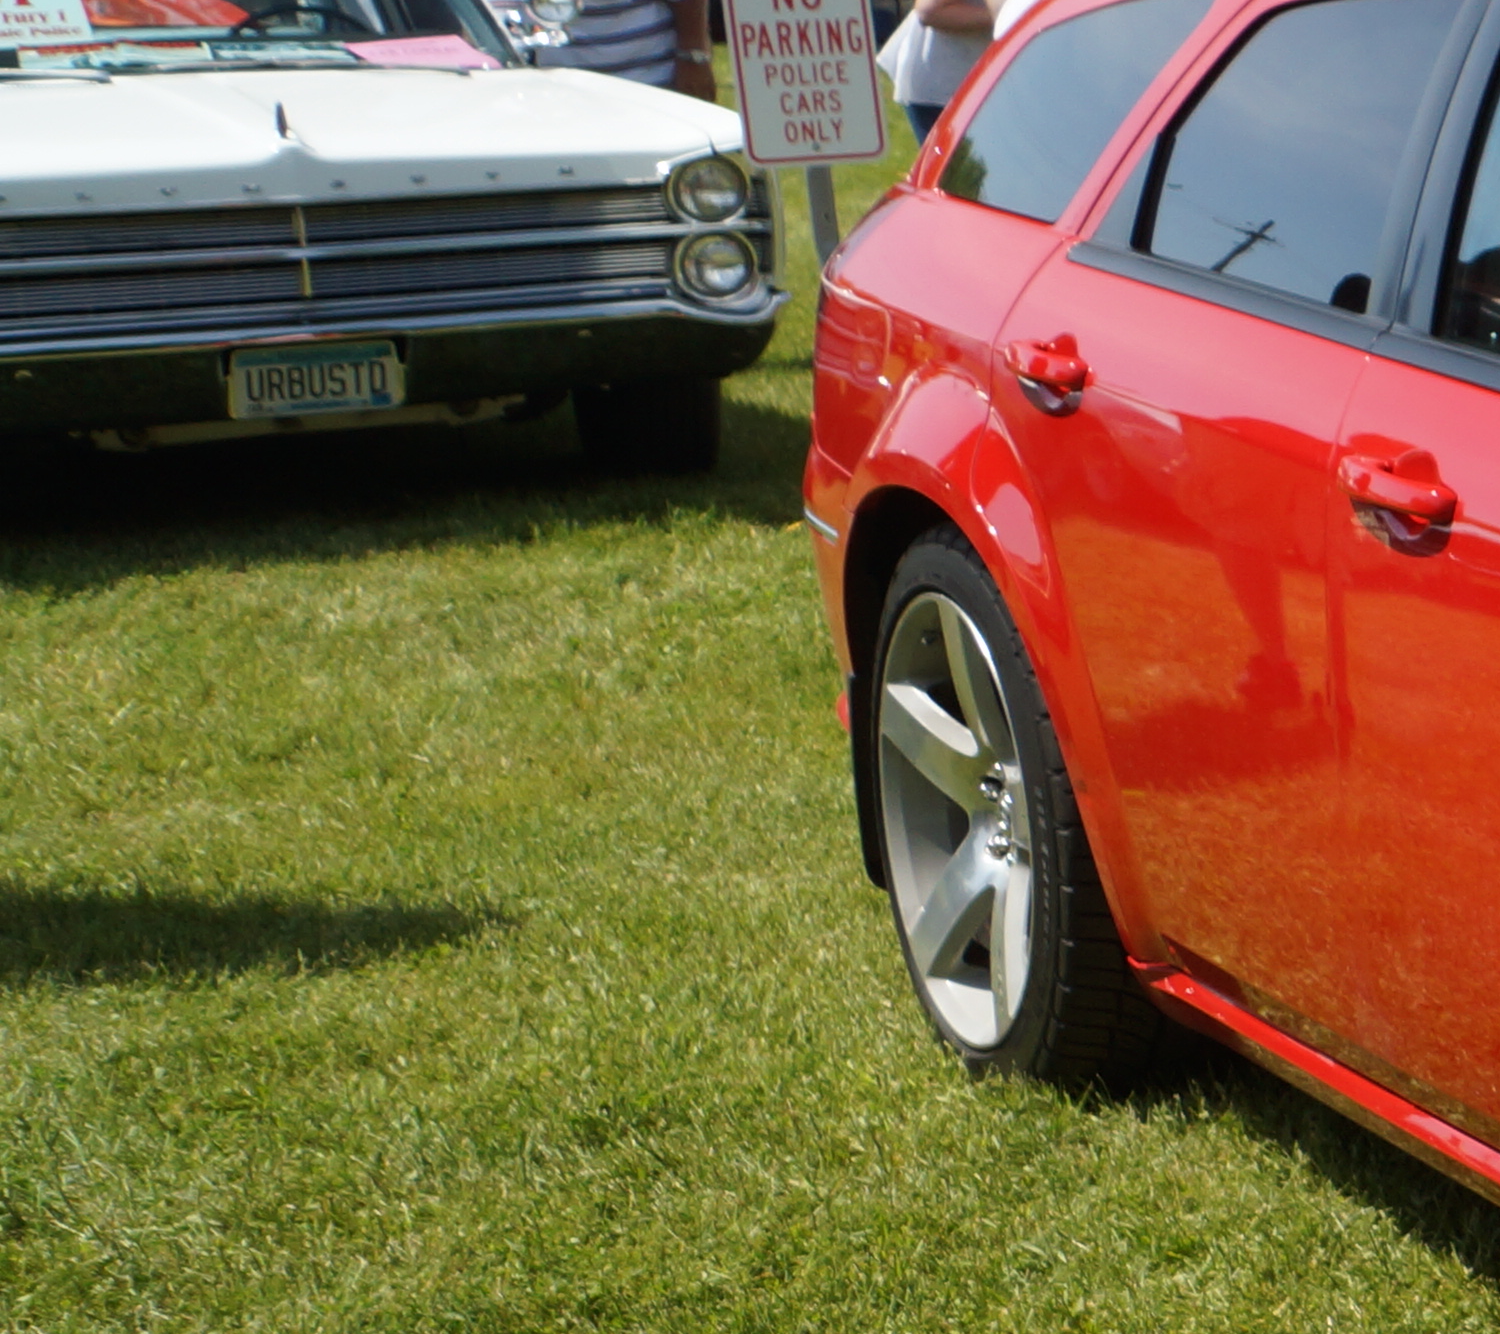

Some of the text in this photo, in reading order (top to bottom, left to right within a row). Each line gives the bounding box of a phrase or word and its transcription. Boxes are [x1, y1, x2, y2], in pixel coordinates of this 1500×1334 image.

[740, 17, 864, 59] PARKING
[764, 59, 849, 88] POLICE
[779, 88, 843, 115] CARS
[783, 118, 844, 145] ONLY
